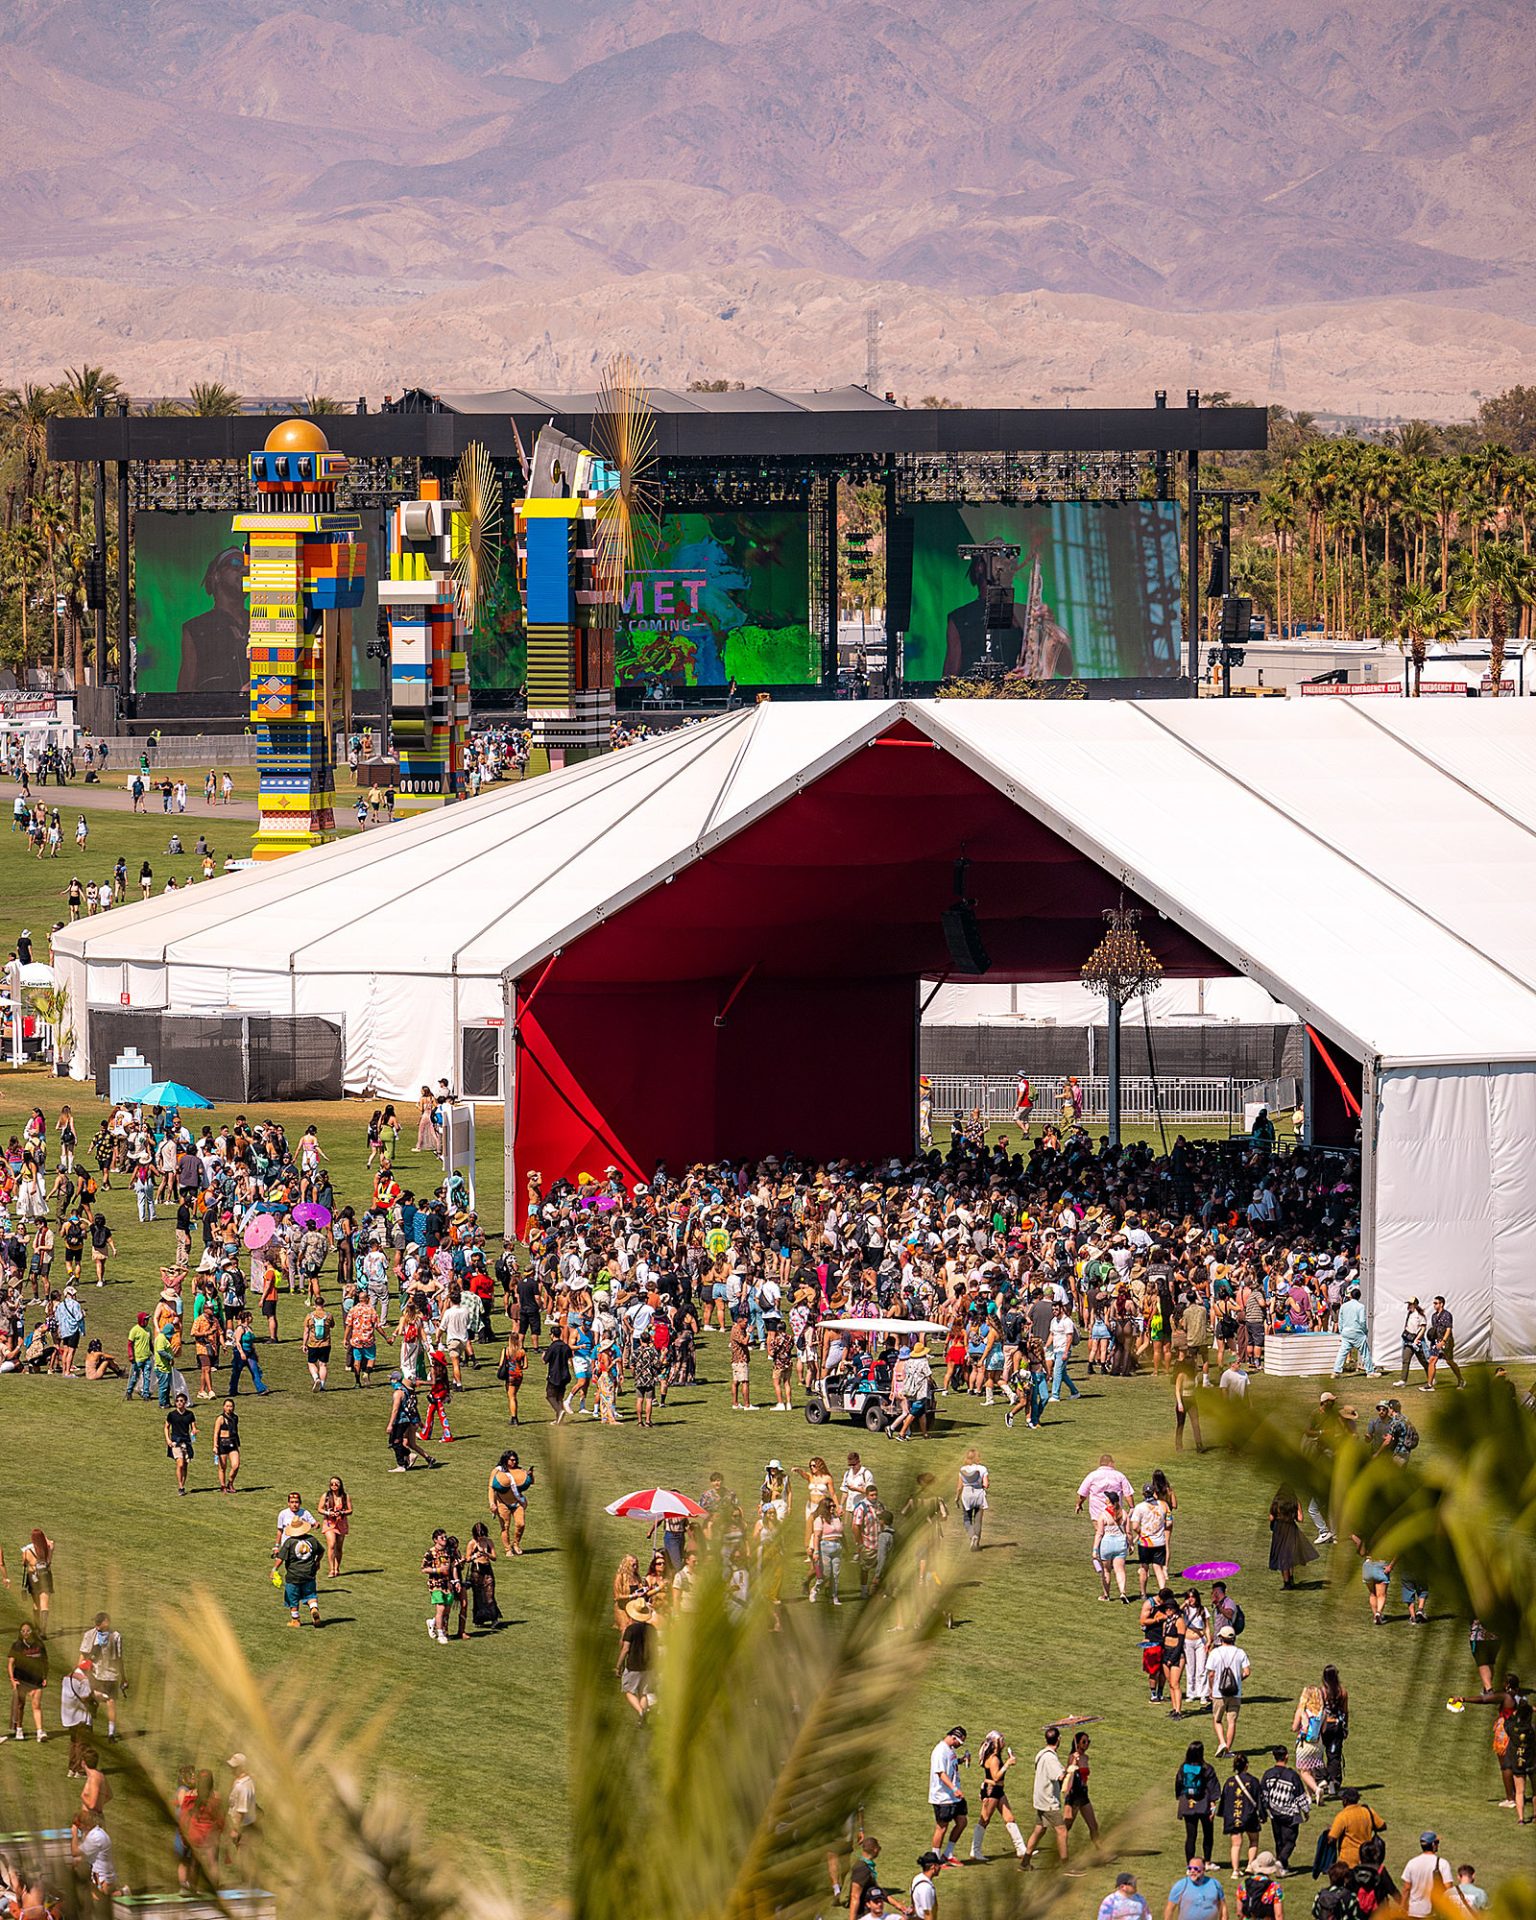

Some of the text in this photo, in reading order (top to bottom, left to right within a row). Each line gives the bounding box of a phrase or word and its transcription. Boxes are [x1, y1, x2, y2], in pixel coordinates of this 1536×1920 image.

[1303, 683, 1400, 693] EMERGENCY EXIT EMERGENCY EXIT
